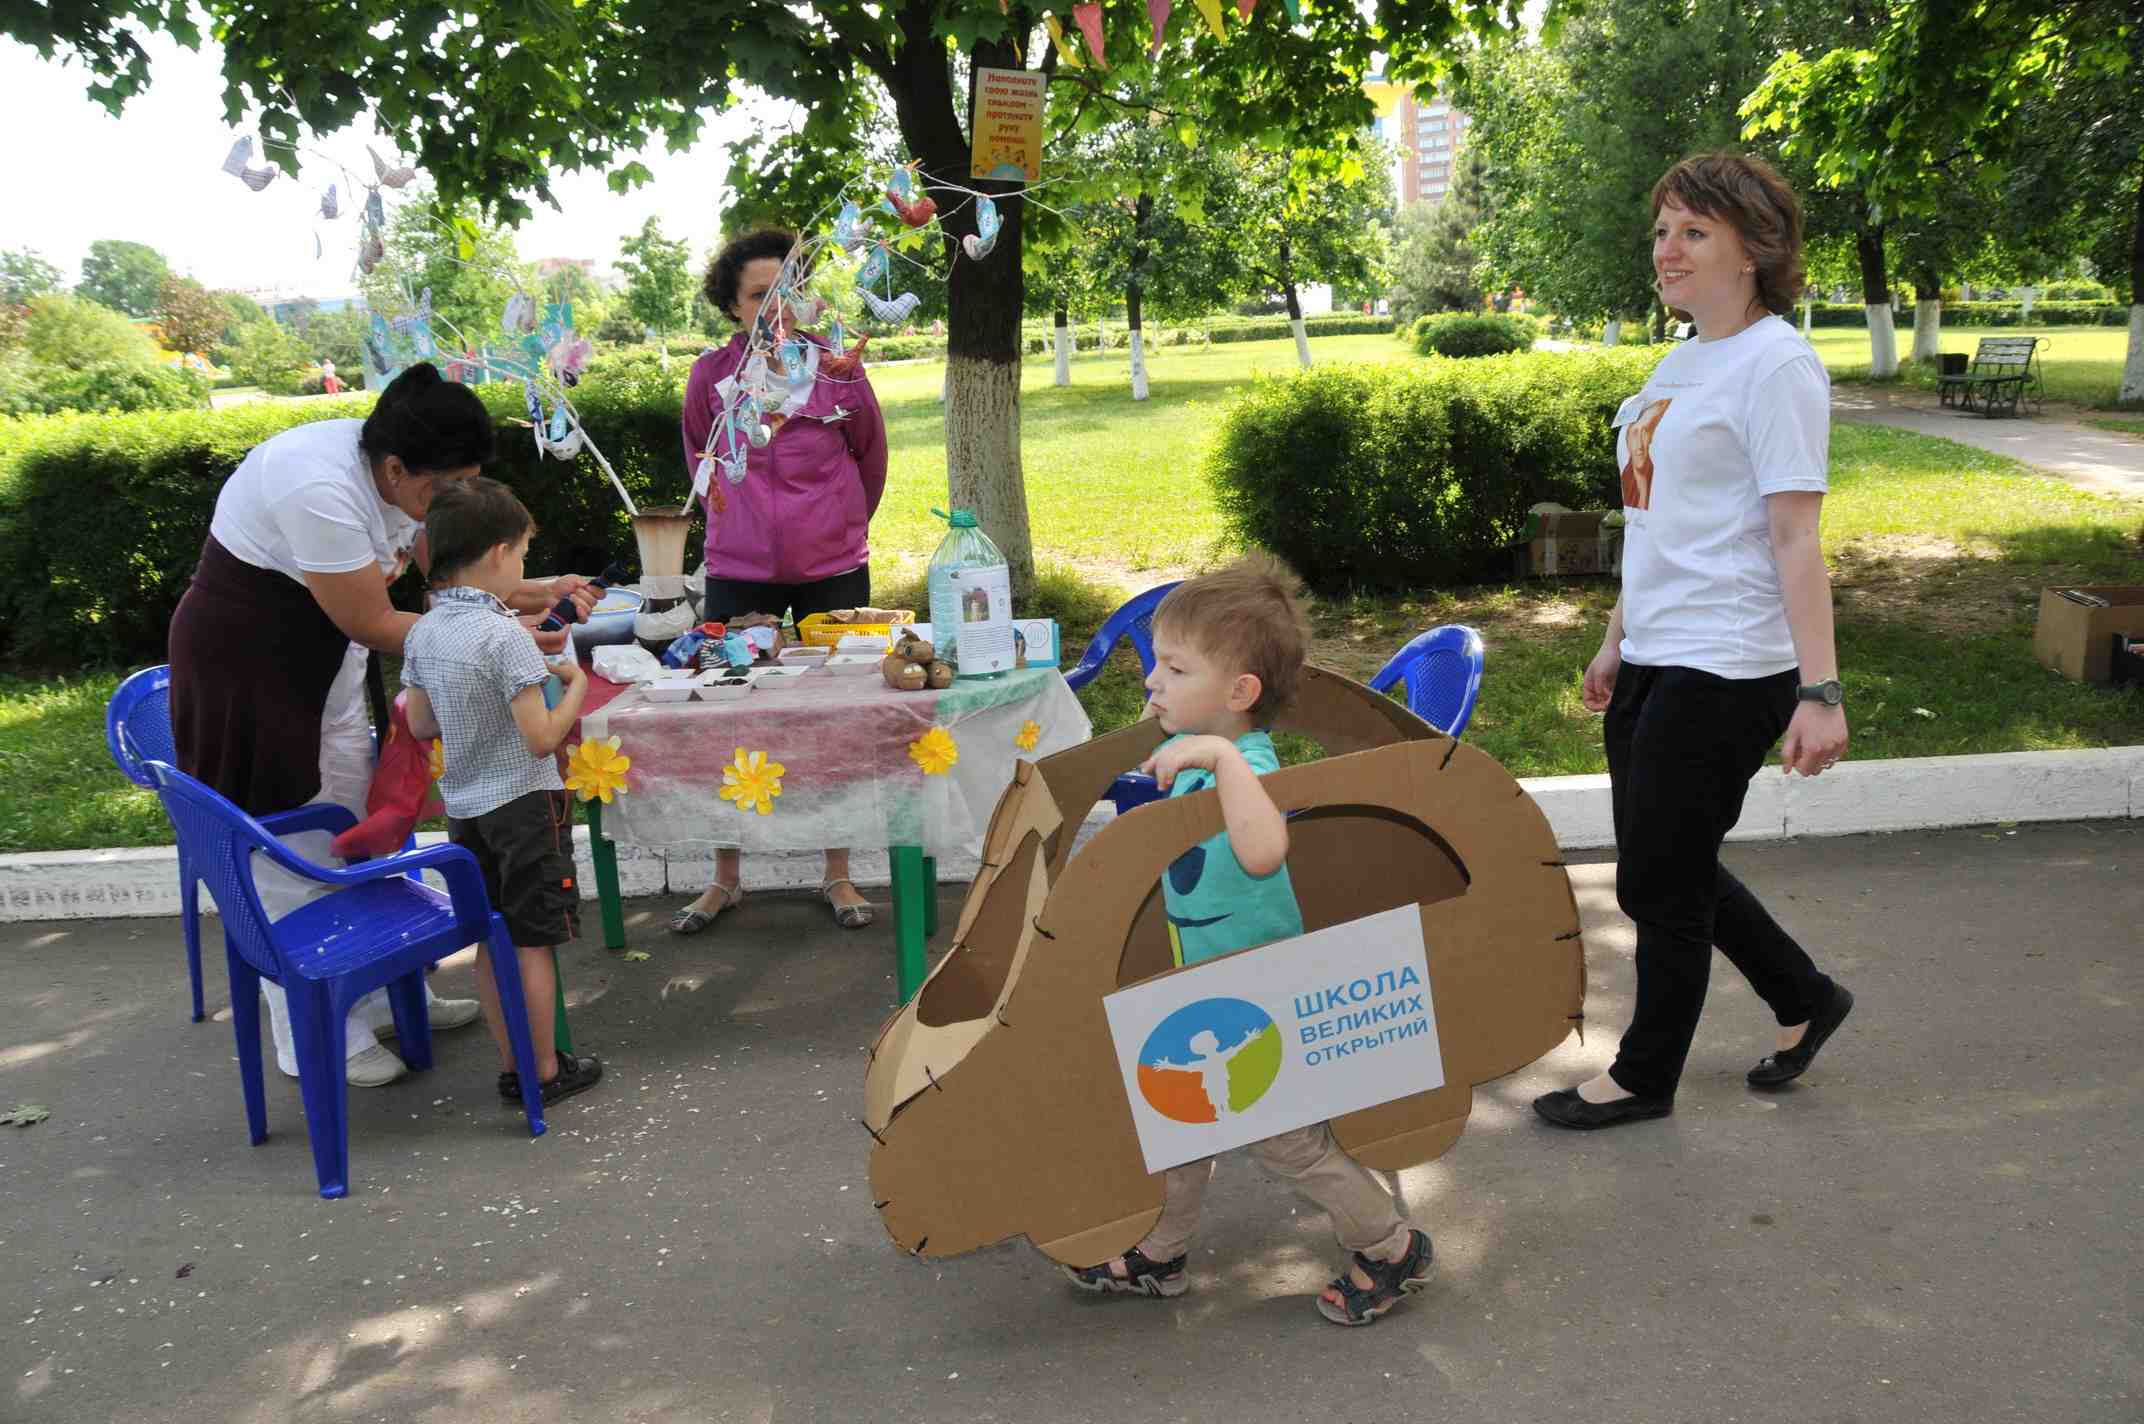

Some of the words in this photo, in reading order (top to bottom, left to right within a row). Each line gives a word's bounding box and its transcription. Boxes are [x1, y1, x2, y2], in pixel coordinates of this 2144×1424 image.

[1294, 966, 1421, 1020] ШКОЛА
[1299, 994, 1425, 1045] ВЕЛИКИХ
[1305, 1016, 1429, 1066] ОТКРЫТИЙ
